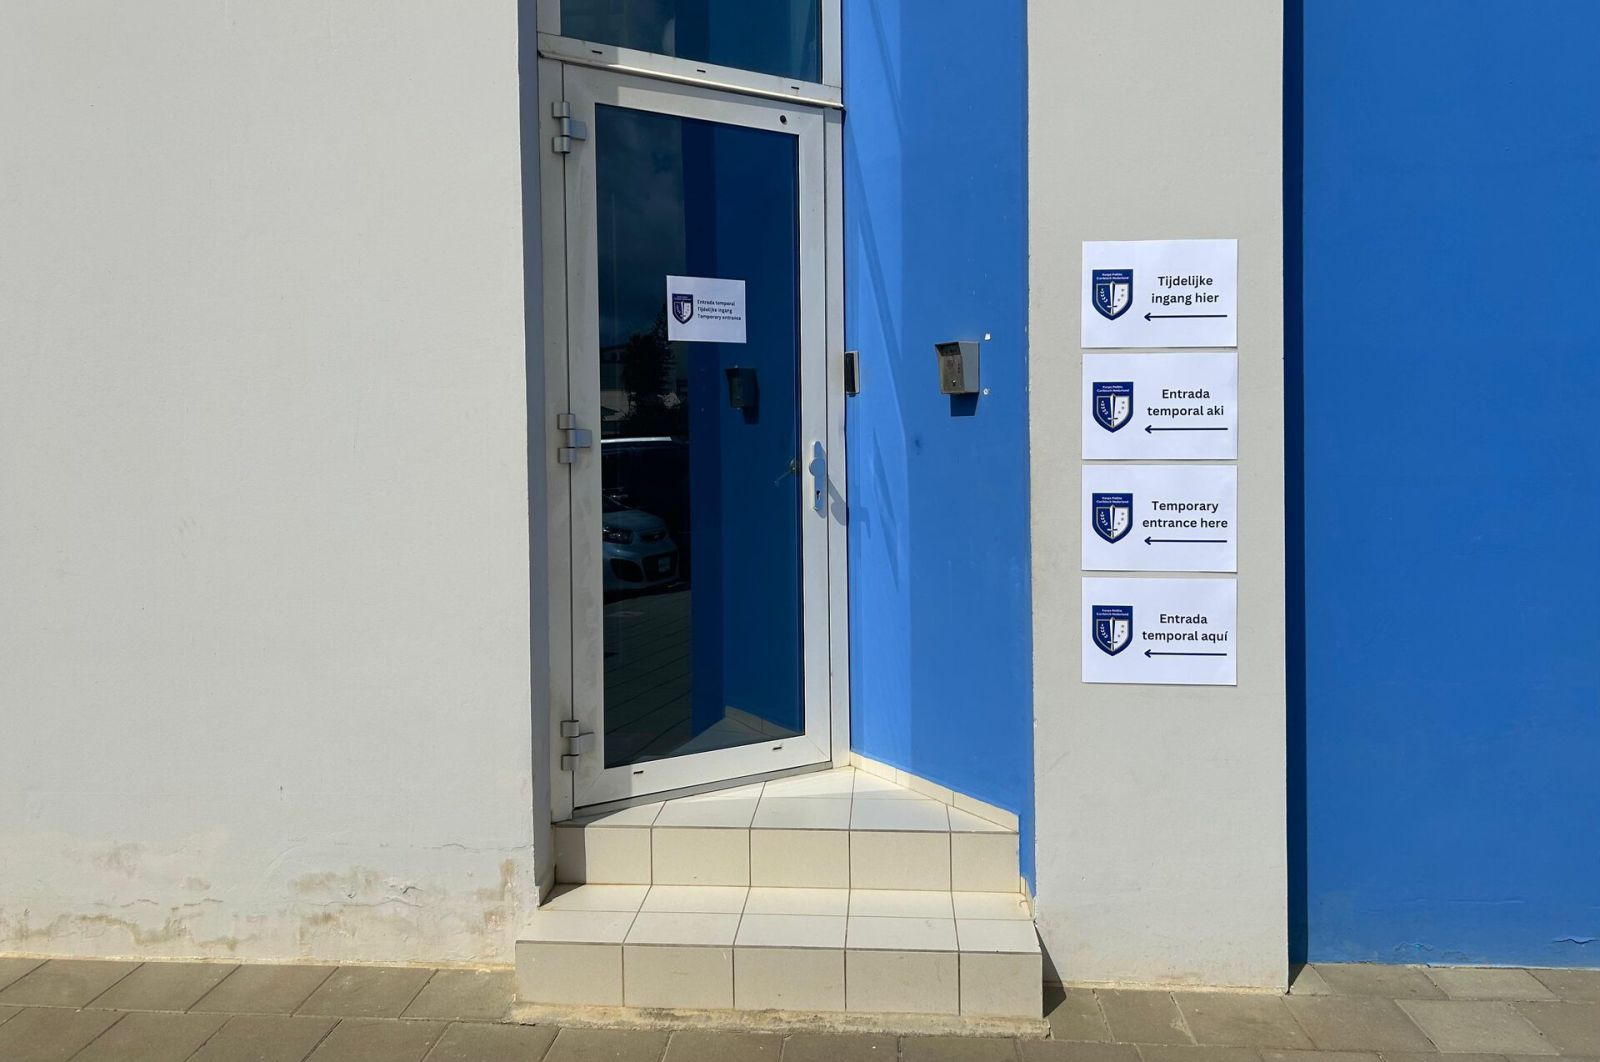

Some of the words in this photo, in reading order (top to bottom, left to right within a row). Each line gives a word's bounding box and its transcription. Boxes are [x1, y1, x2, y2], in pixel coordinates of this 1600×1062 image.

[1158, 276, 1213, 289] Tijdelijke
[1152, 293, 1192, 306] ingang
[1195, 293, 1219, 303] hier
[1162, 389, 1210, 399] Entrada
[1148, 406, 1204, 418] temporal
[1206, 406, 1224, 416] aki
[1152, 501, 1219, 513] Temporary
[1143, 519, 1197, 528] entrance
[1200, 518, 1228, 528] here
[1160, 614, 1208, 624] Entrada
[1142, 631, 1198, 643] temporal
[1201, 631, 1228, 643] aquí
